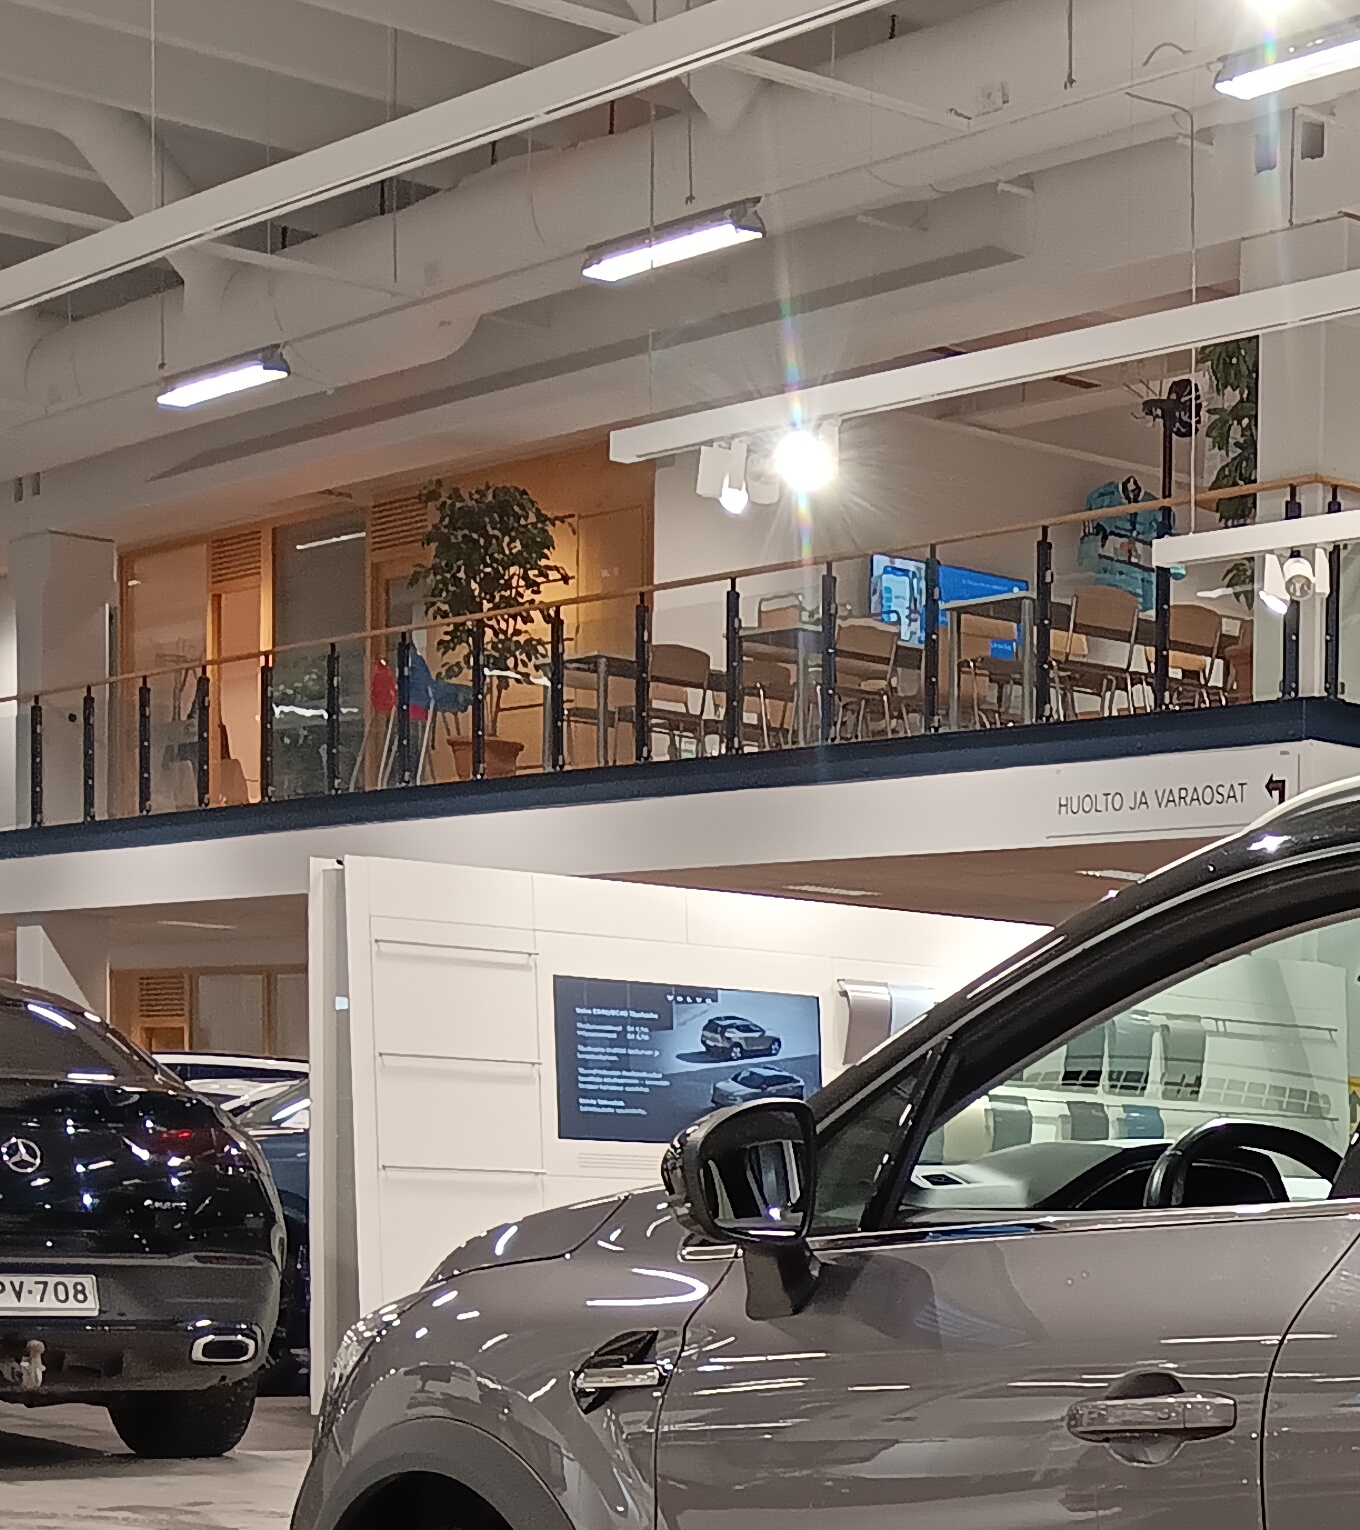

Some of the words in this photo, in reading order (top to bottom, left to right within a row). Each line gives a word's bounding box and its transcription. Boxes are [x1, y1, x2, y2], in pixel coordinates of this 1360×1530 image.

[1058, 792, 1124, 816] HUOLTO
[1129, 791, 1150, 812] JA
[1155, 781, 1249, 808] VARAOSAT
